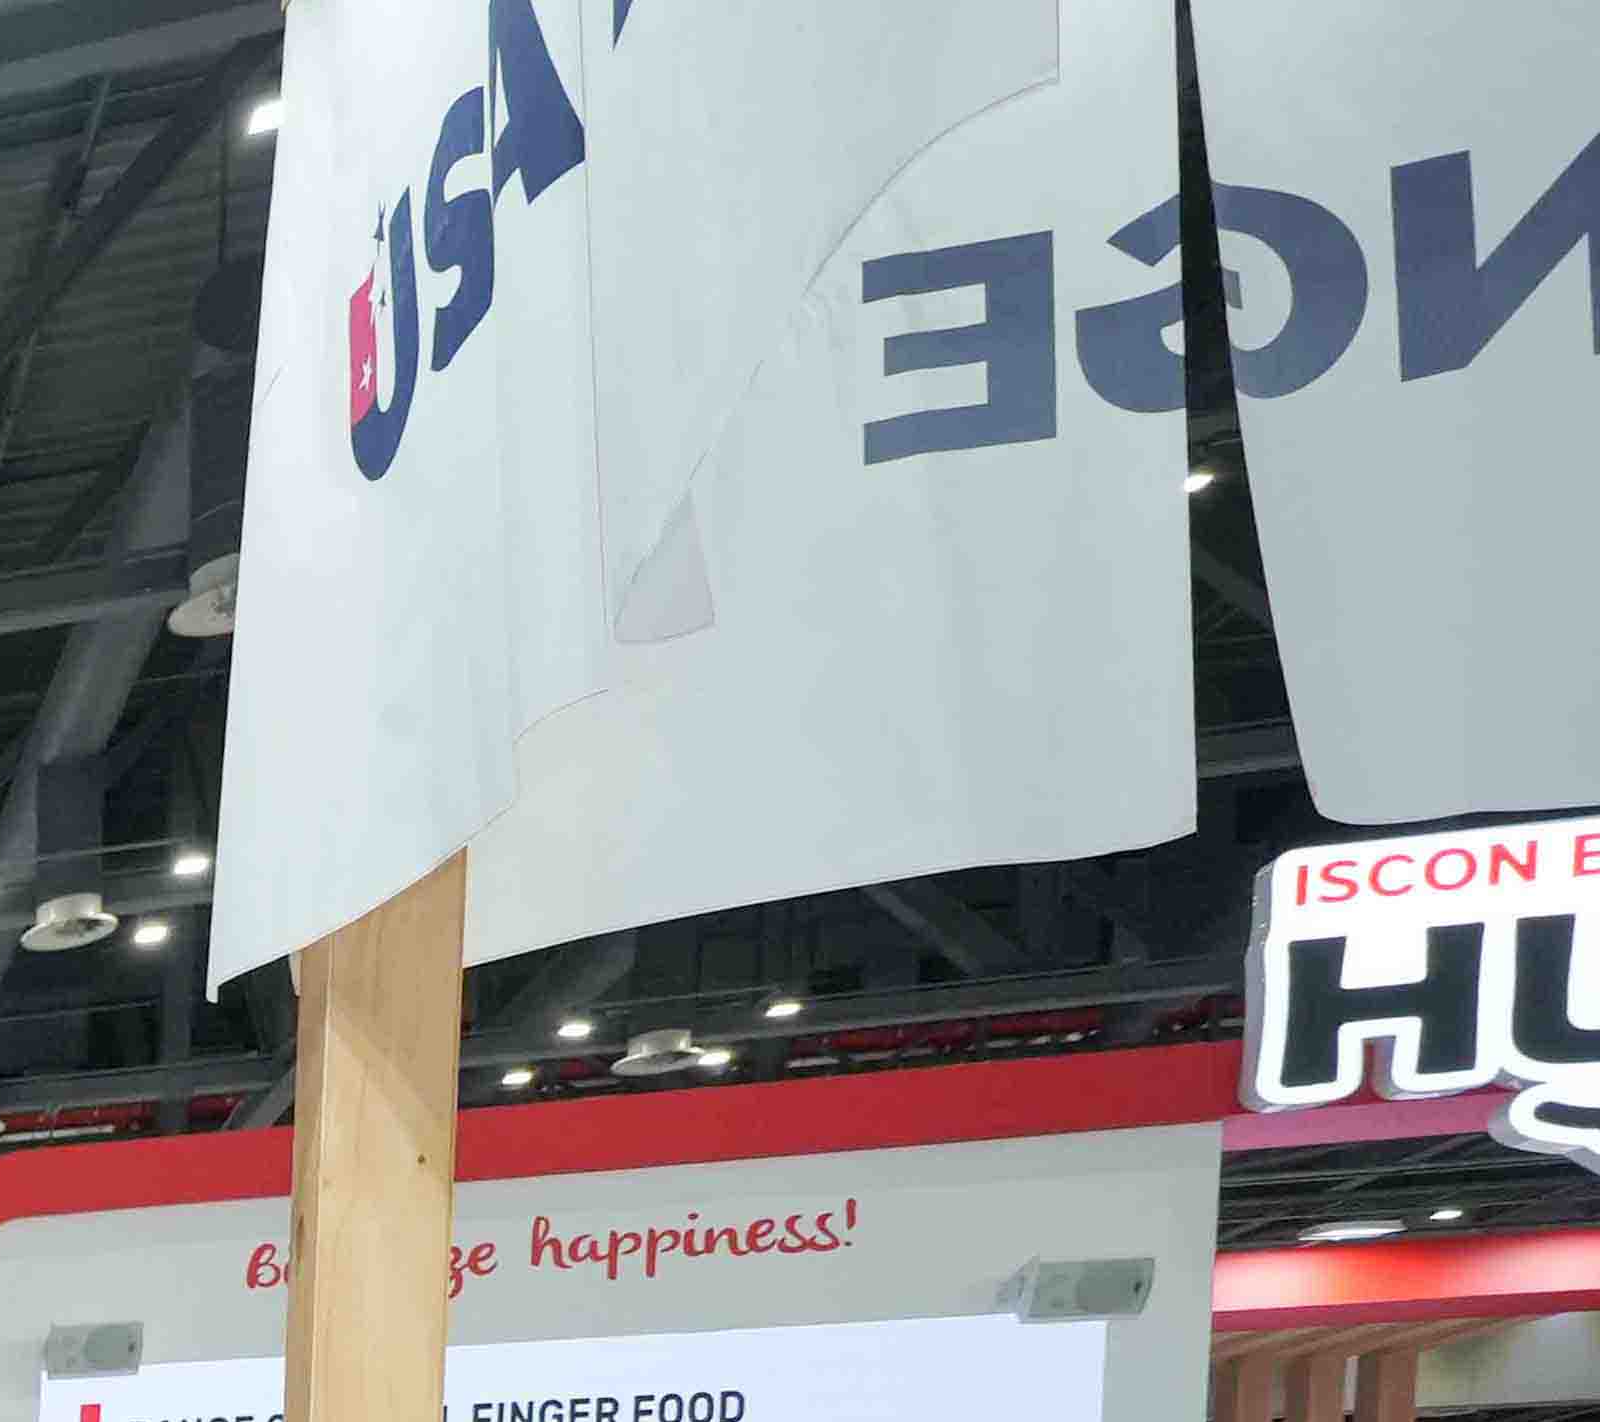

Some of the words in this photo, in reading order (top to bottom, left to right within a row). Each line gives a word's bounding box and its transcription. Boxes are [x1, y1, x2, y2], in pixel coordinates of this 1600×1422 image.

[349, 0, 586, 482] USA
[1295, 839, 1538, 906] ISCON
[529, 1197, 858, 1280] happiness!
